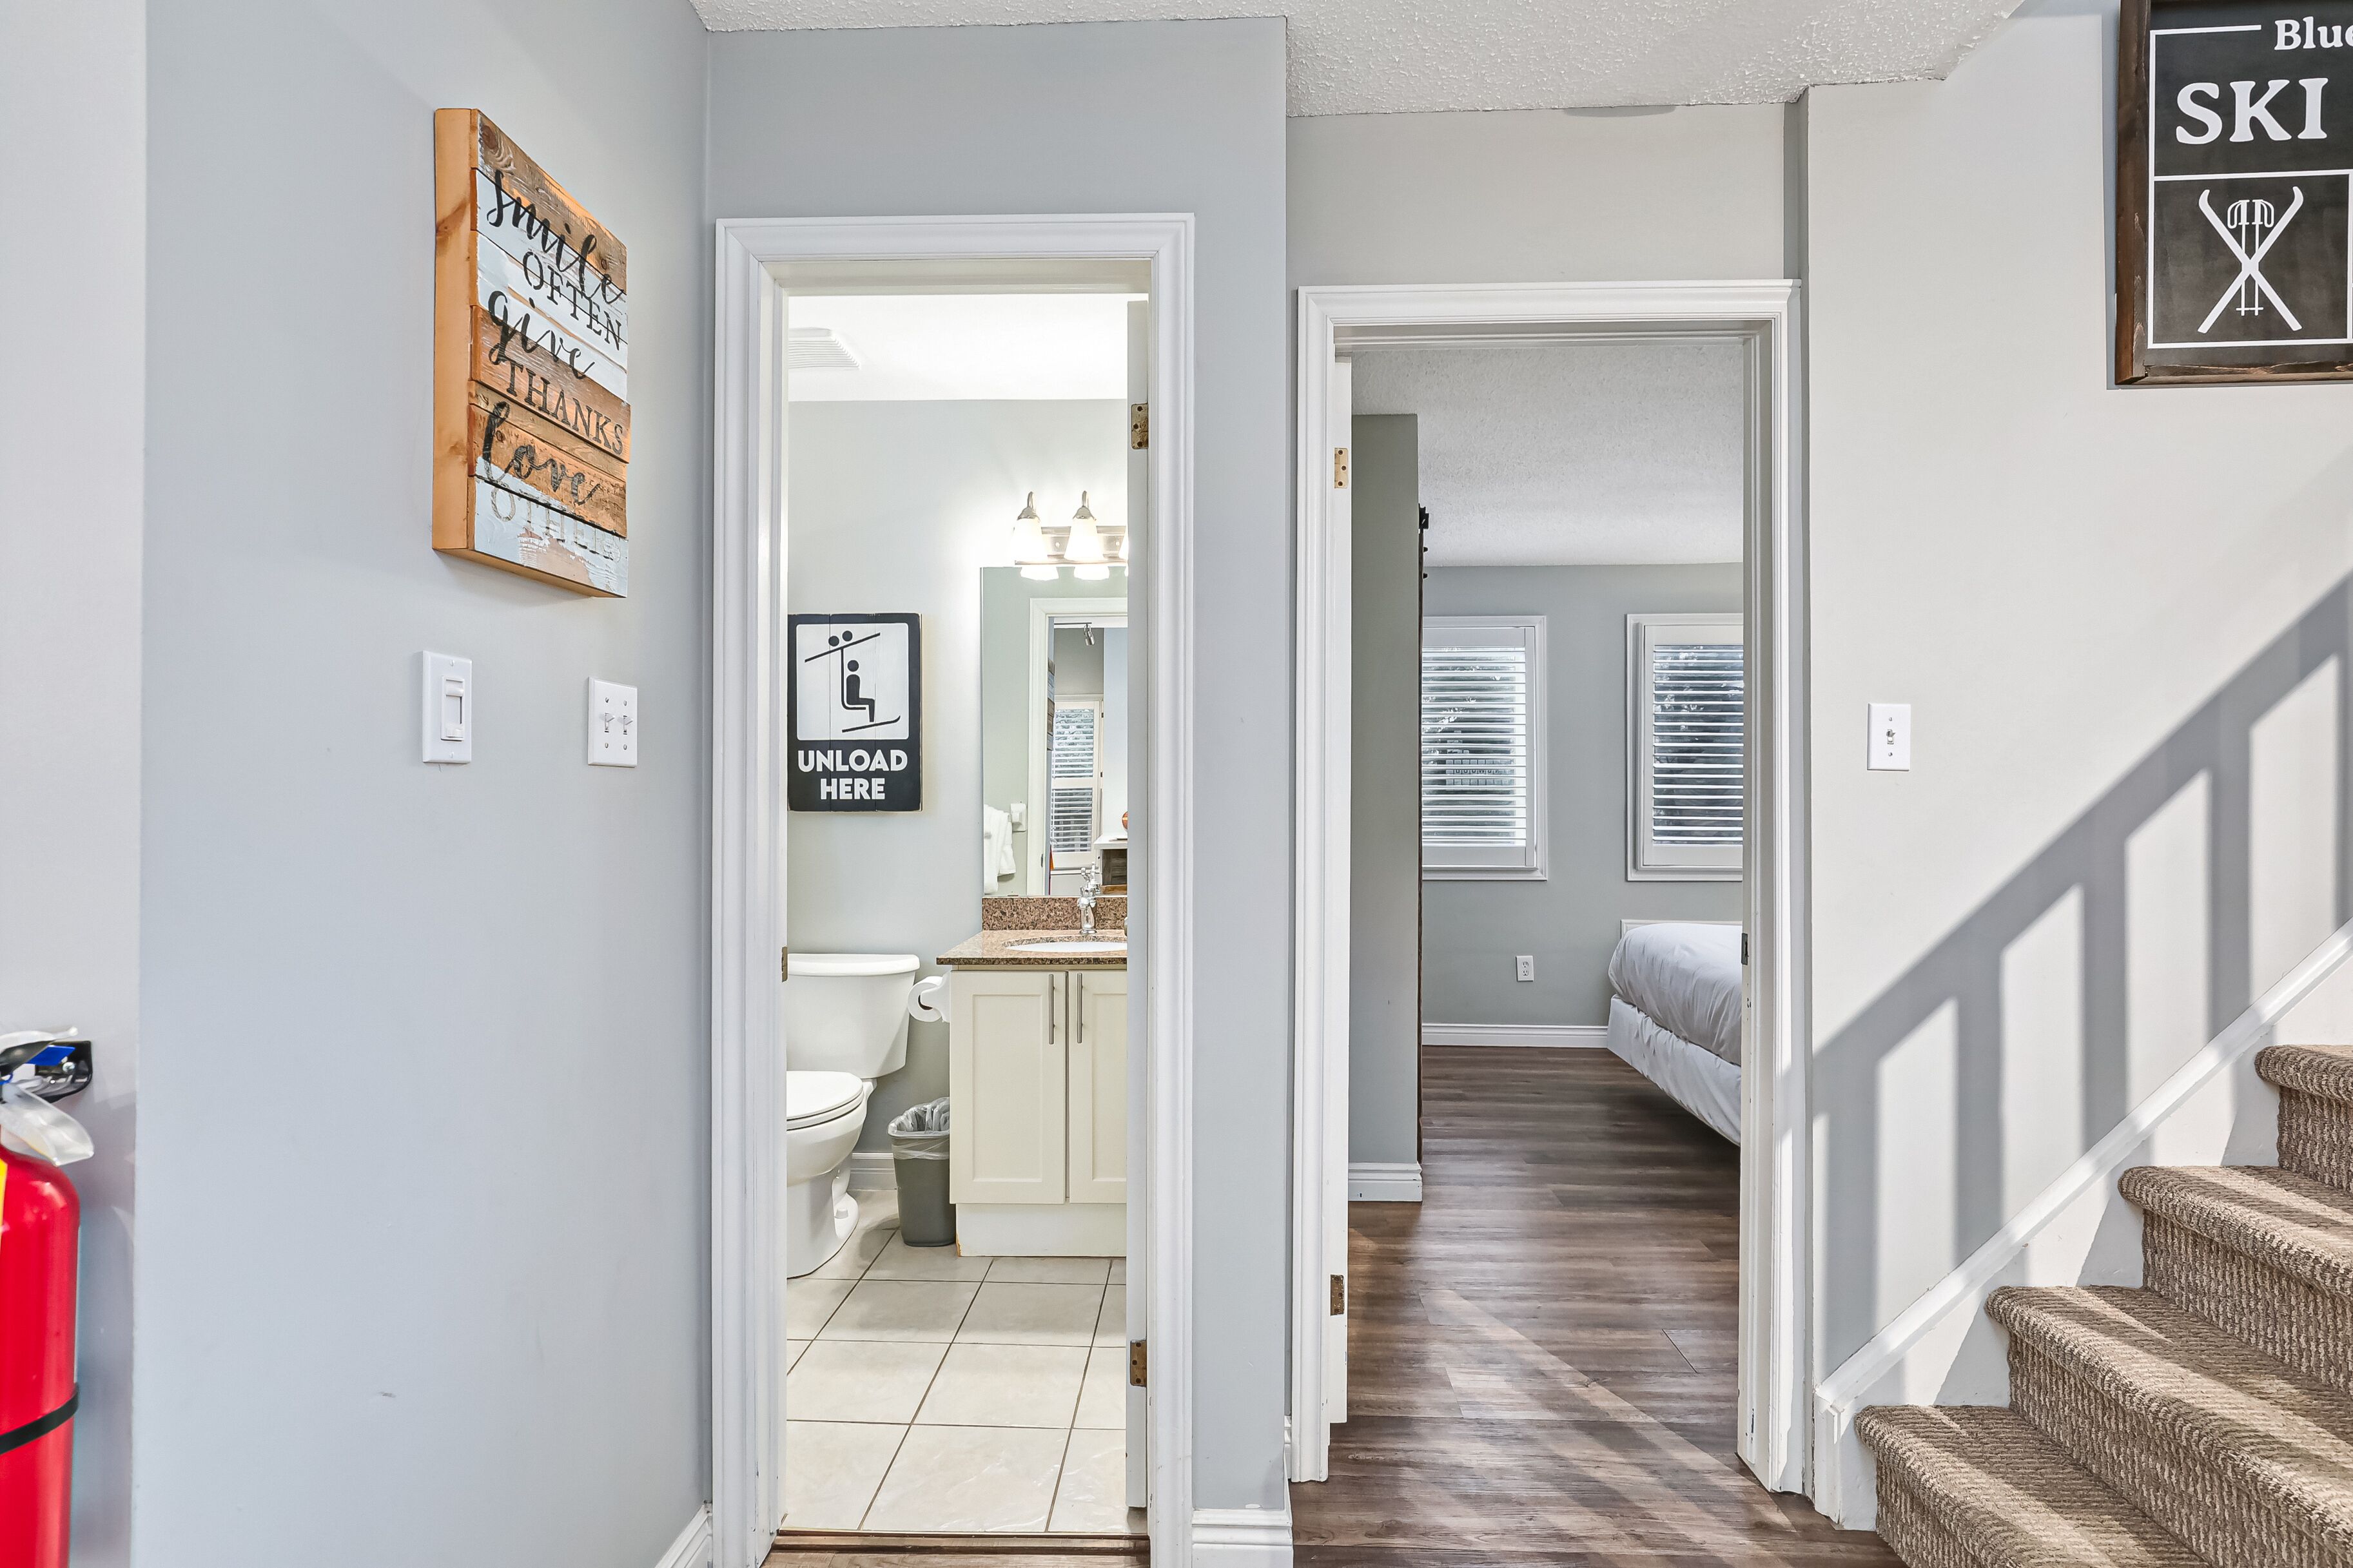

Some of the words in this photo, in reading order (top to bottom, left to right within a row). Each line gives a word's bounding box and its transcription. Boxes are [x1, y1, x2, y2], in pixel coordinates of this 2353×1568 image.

[2176, 78, 2329, 144] SKI
[489, 291, 595, 379] give
[523, 251, 621, 350] OFTEN
[506, 359, 623, 455] THANKS
[797, 750, 908, 772] UNLOAD
[820, 778, 885, 800] HERE
